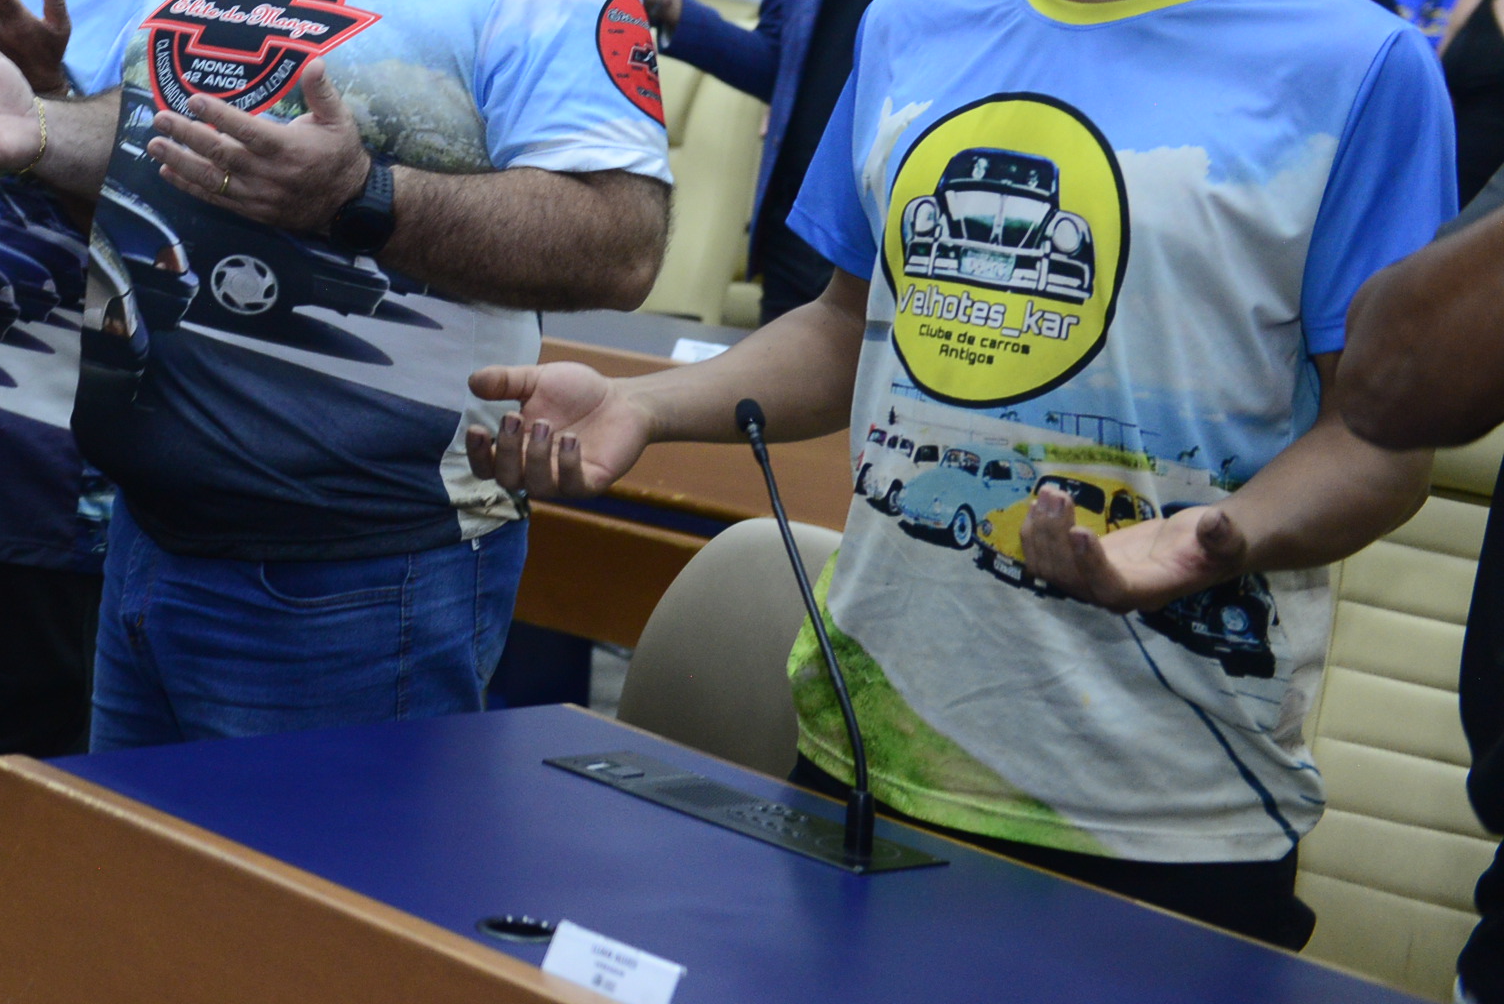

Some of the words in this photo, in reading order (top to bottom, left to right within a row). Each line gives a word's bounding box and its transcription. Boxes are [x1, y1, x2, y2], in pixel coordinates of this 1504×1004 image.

[219, 5, 248, 24] do
[246, 4, 330, 39] Monza
[191, 58, 246, 77] MONZA
[203, 73, 248, 91] ANOS
[898, 283, 1081, 341] Velhotes_kar
[918, 323, 953, 341] Clube
[957, 331, 976, 346] de
[980, 334, 1031, 355] carros
[938, 343, 995, 366] Antigos
